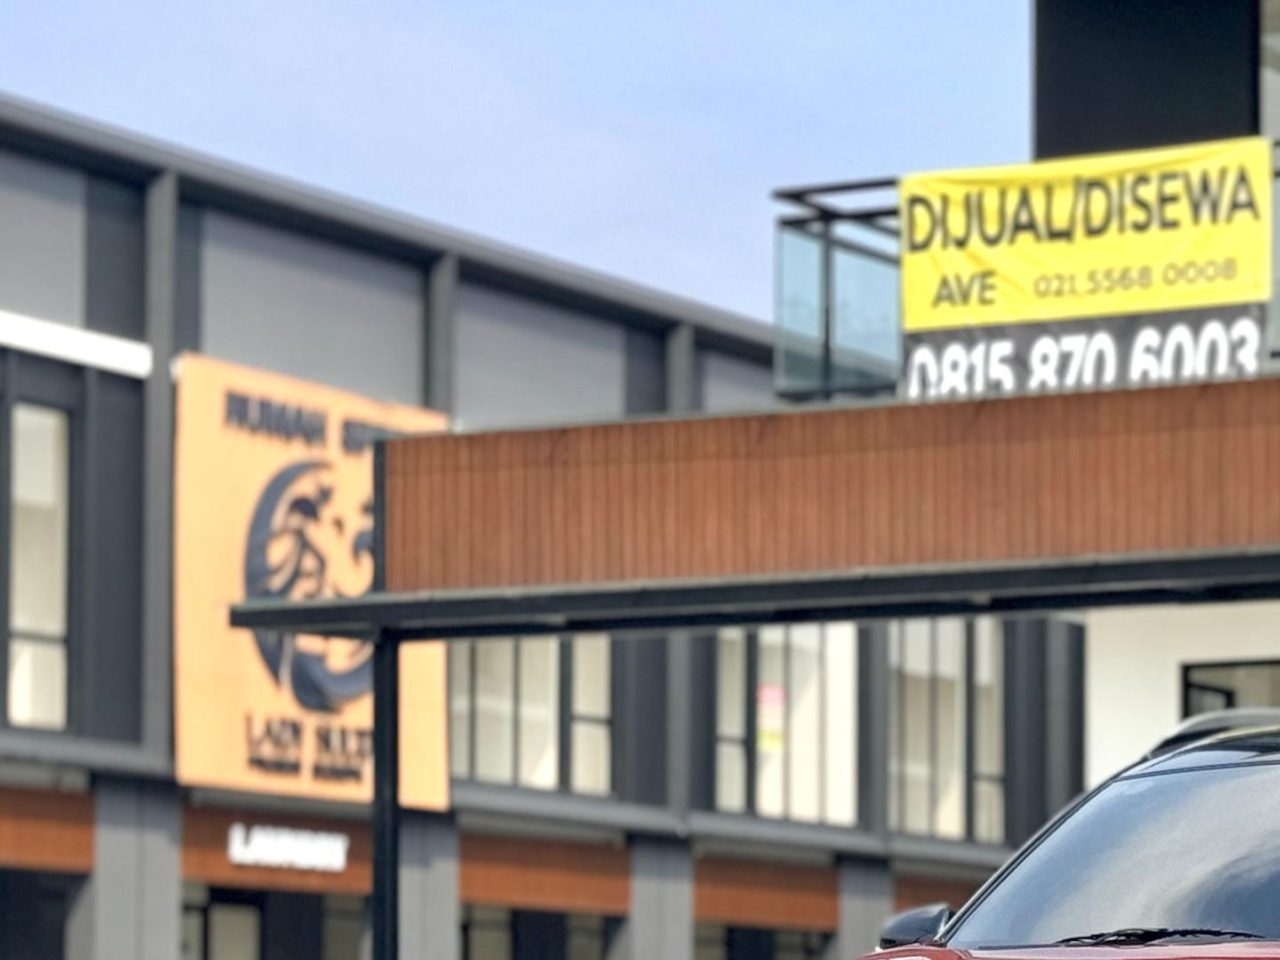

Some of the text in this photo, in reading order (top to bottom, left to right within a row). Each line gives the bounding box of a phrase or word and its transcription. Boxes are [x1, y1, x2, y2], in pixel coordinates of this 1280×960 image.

[907, 166, 1261, 252] DIJUAL/DISEWA
[932, 270, 997, 308] AVE
[1162, 256, 1238, 286] 0008
[908, 338, 1015, 398] 0815
[1029, 331, 1117, 390] 870
